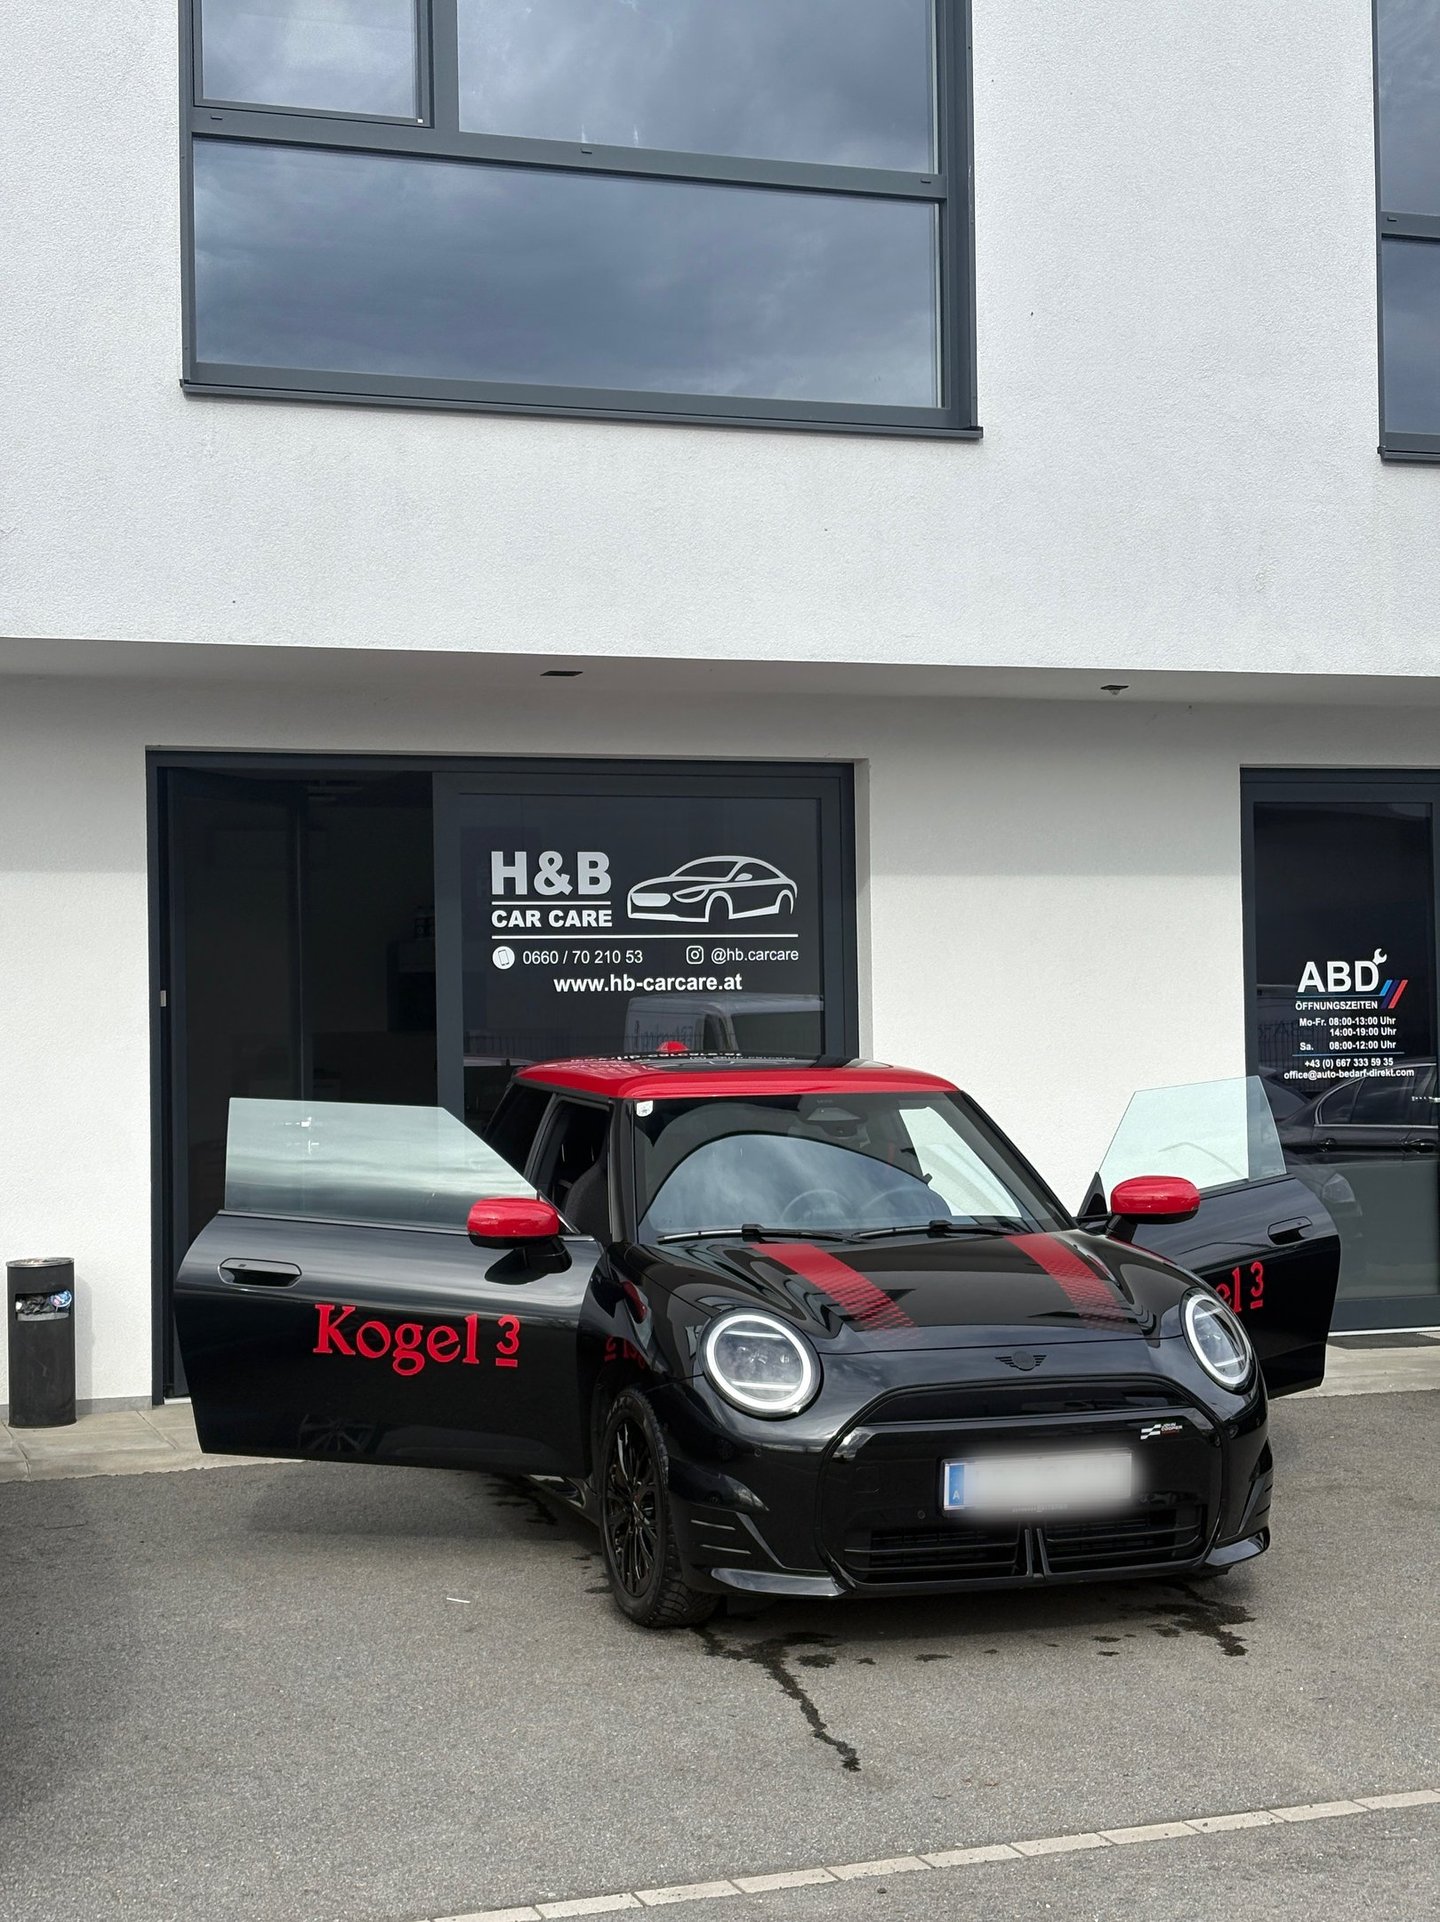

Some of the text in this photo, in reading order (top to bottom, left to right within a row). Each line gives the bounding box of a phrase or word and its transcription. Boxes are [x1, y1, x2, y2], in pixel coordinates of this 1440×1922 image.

[492, 851, 611, 895] H&B
[492, 910, 612, 927] CAR CARE
[523, 950, 643, 964] 0660 / 70 210 53
[711, 948, 798, 964] @hb.carcare
[554, 974, 742, 992] www.hb-carcare.at
[1297, 960, 1380, 993] ABD
[1296, 1001, 1378, 1010] ÖFFNUNGSZEITEN
[1300, 1018, 1327, 1026] Mo-Fr.
[1329, 1017, 1379, 1025] 08:00-13:00
[1330, 1027, 1397, 1036] 14:00-19:00 Uhr
[1300, 1042, 1314, 1050] Sa.
[1329, 1041, 1379, 1050] 08:00-12:00
[1305, 1058, 1394, 1069] +43 (0) 667 333 59 35
[1284, 1068, 1415, 1081] office@auto-bedarf-direkt.com
[1250, 1261, 1264, 1309] 3
[313, 1304, 521, 1376] Kogel 3
[952, 1490, 960, 1500] A
